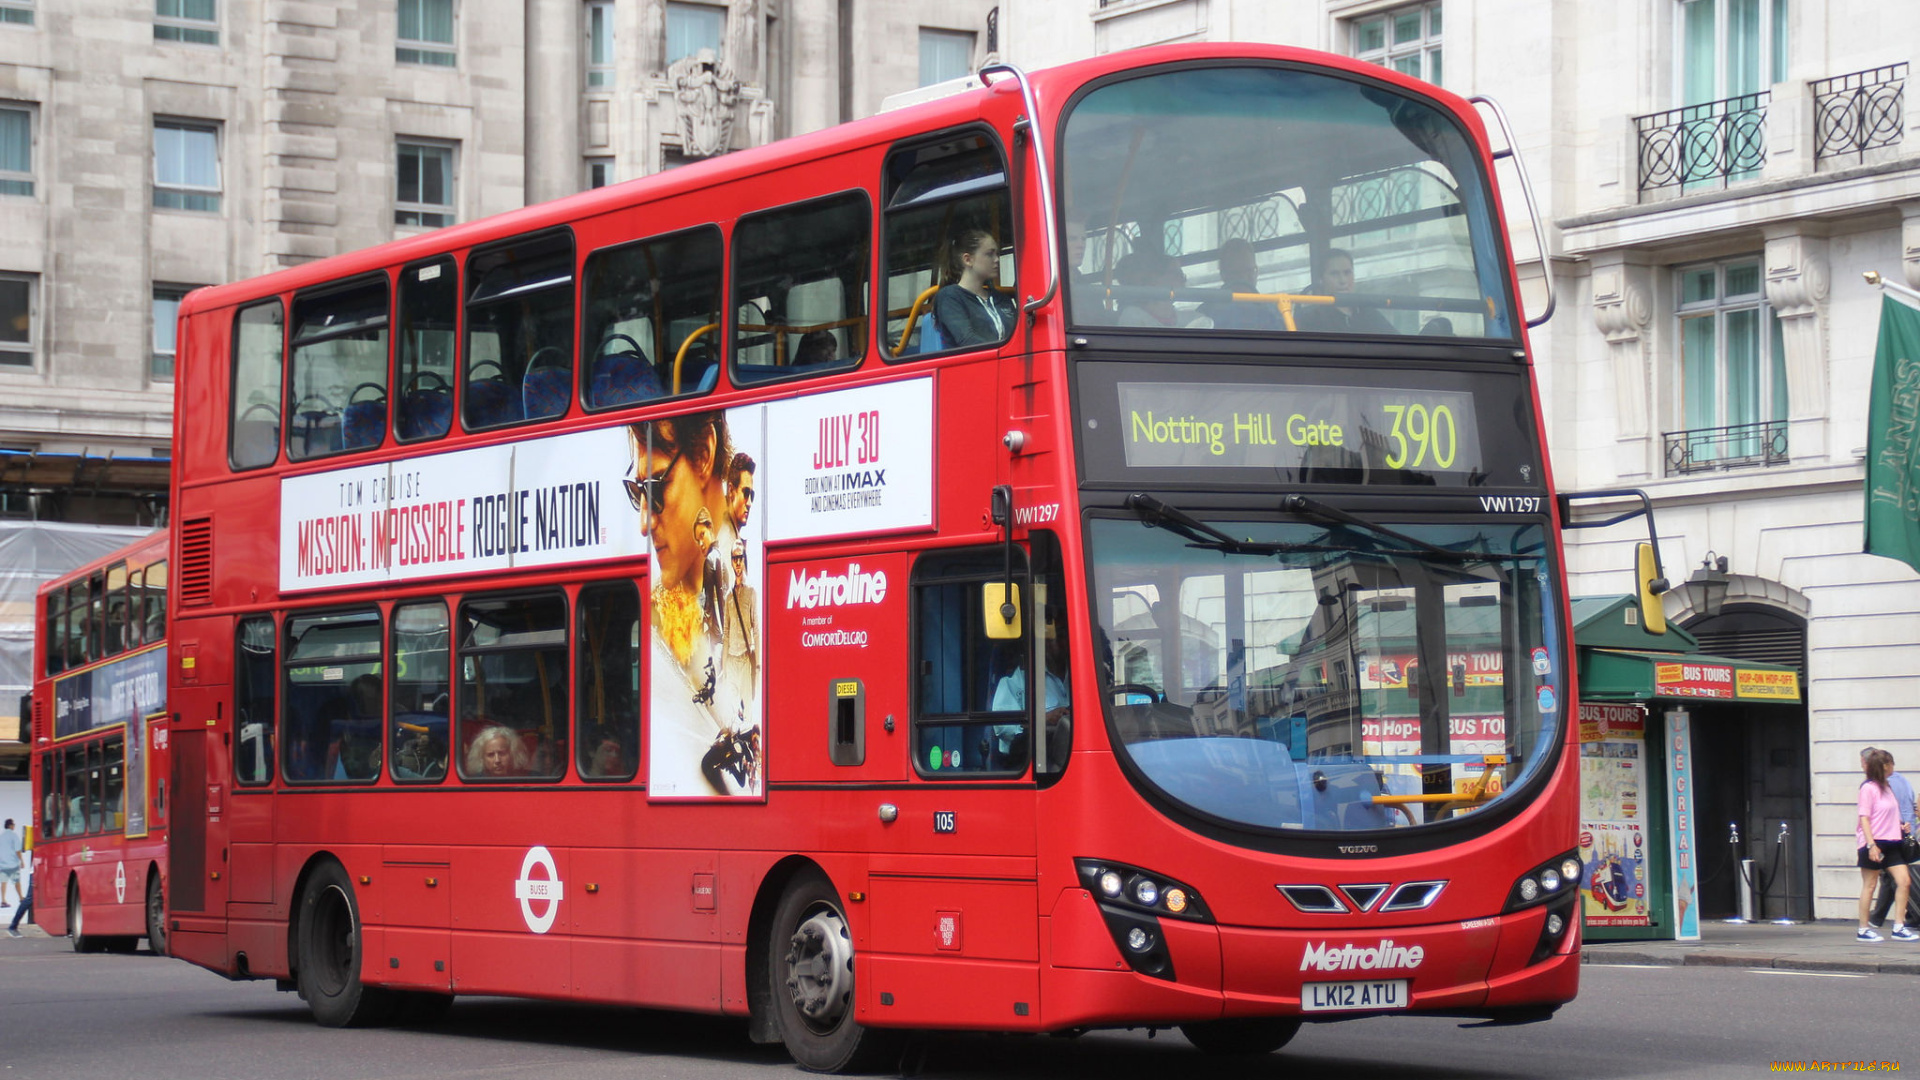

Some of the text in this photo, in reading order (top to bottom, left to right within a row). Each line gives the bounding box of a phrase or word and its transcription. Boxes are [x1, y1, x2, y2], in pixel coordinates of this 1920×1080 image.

[813, 410, 879, 470] JULY 30
[1131, 403, 1456, 469] Notting Hill Gate 390
[340, 471, 420, 508] TOM CRUISE
[805, 469, 886, 494] BOOK NOW AT IMAX
[810, 489, 882, 513] AND CINEMAS EVERYWHERE
[1479, 496, 1541, 513] VW1297
[1015, 503, 1059, 525] VW1297
[298, 480, 600, 578] MISSION: IMPOSSIBLE ROGUE NATION
[786, 563, 887, 609] Metroline
[802, 615, 833, 626] A member of
[1447, 652, 1504, 673] US TOU
[1683, 666, 1731, 682] BUS TOURS
[837, 684, 856, 695] DIESEL
[1579, 706, 1639, 722] BUS TOURS
[1362, 720, 1420, 739] on Hop-
[1481, 718, 1506, 735] TO
[937, 813, 954, 831] 105
[1675, 776, 1690, 869] CREAM
[1338, 845, 1378, 854] VOLVO
[530, 884, 548, 895] BUSES
[1299, 939, 1424, 972] Metroline
[1313, 983, 1396, 1007] LK12 ATU
